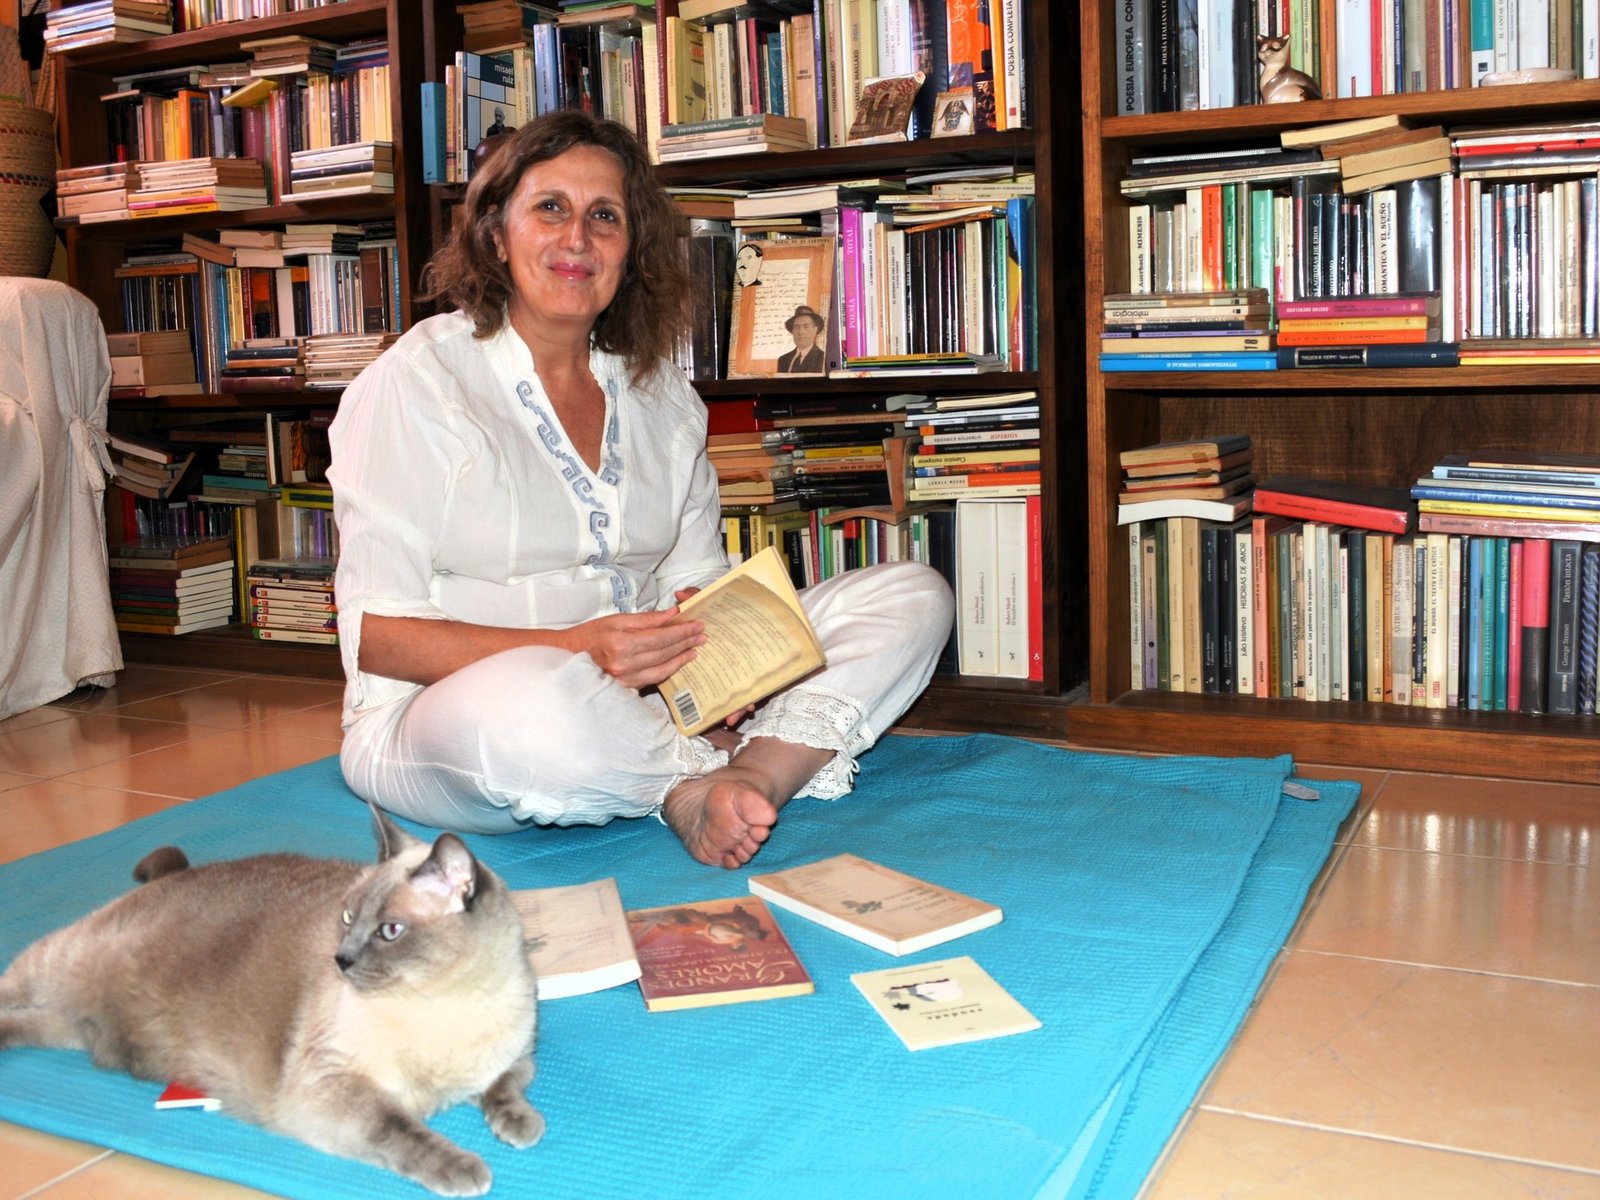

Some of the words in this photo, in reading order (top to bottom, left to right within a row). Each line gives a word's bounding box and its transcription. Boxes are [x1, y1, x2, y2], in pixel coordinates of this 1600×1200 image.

[1005, 0, 1014, 44] COMPLETA
[1125, 26, 1134, 72] EUROPEA
[494, 64, 514, 75] misael
[853, 49, 861, 81] MAILLARD
[502, 75, 514, 85] ruiz
[1378, 202, 1387, 230] SUEÑO
[846, 226, 854, 254] TOTAL
[1379, 230, 1387, 241] EL
[1312, 245, 1319, 255] DE
[848, 298, 856, 329] POESÍA
[1240, 565, 1247, 575] DE
[1431, 566, 1437, 575] EL
[1563, 553, 1572, 578] intacta
[1240, 576, 1248, 610] HISTORIAS
[1431, 597, 1437, 605] EL
[1563, 579, 1572, 603] Pasión
[1240, 616, 1248, 642] kristeva
[1240, 643, 1249, 657] julia
[647, 960, 796, 991] GRANDES
[654, 958, 765, 980] AMORES
